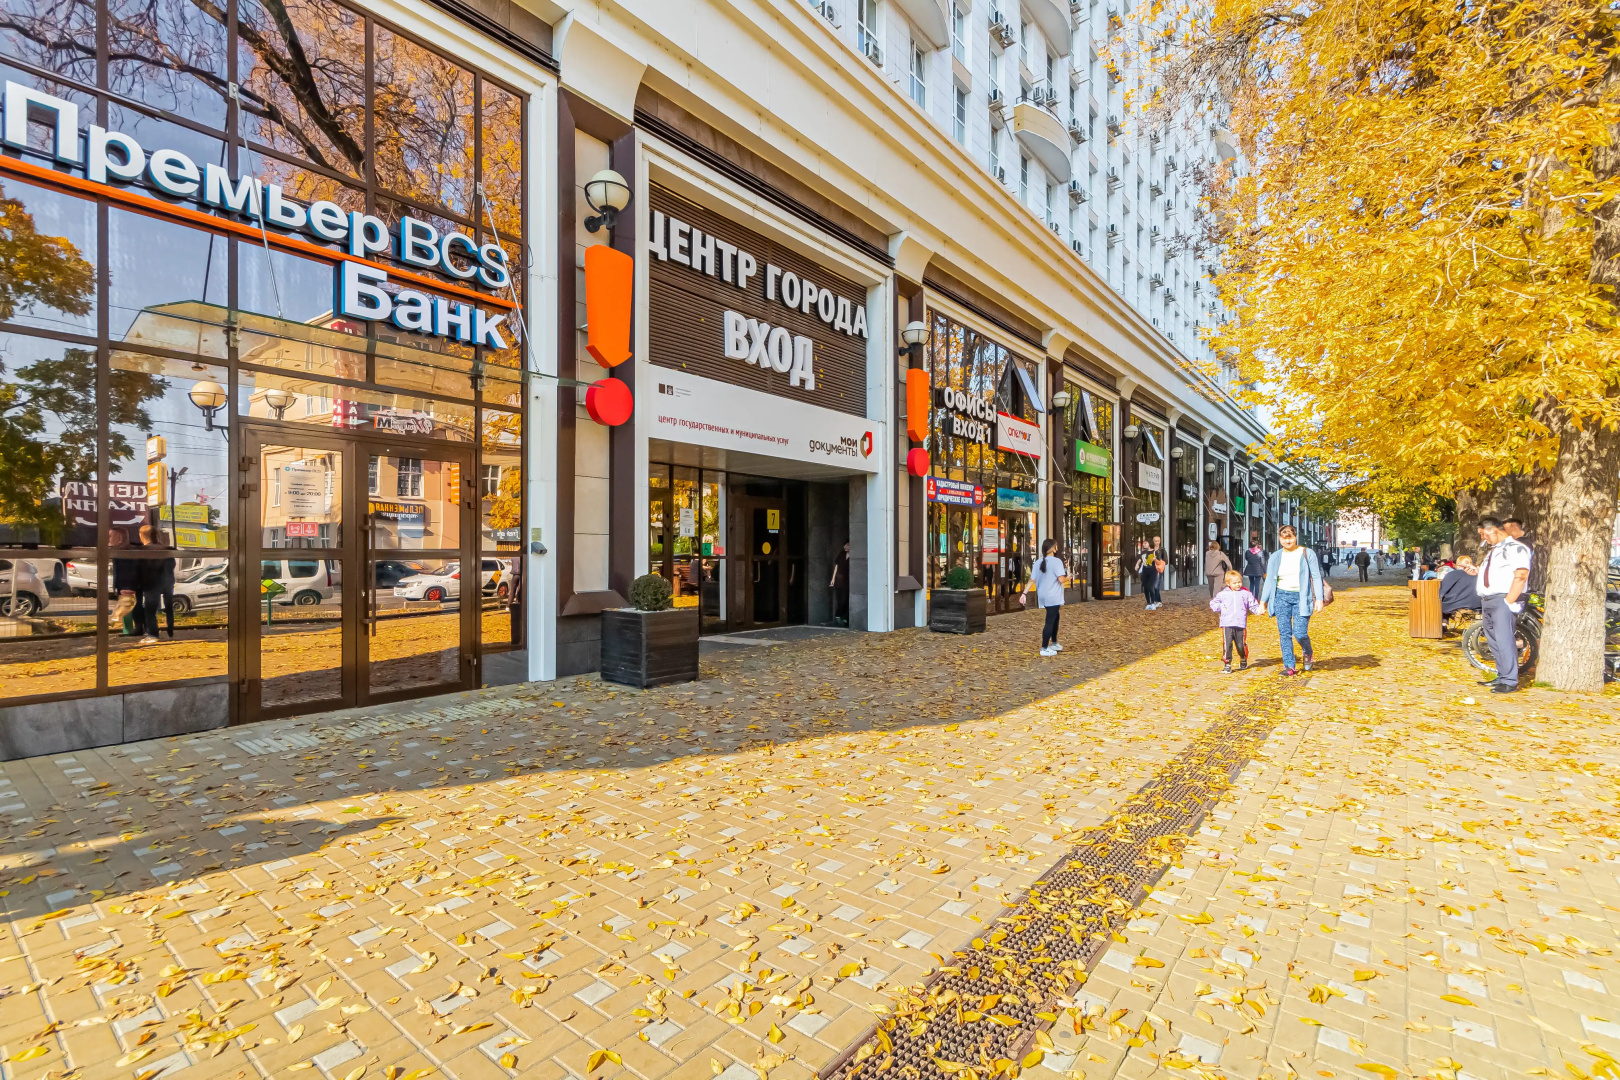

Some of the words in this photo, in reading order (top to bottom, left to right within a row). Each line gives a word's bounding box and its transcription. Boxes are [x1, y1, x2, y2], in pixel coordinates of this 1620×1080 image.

[3, 80, 391, 258] Премьер
[400, 215, 511, 289] BCS
[649, 210, 757, 289] ЦЕНТР
[764, 263, 869, 339] ГОРОДА
[341, 260, 509, 350] Банк
[723, 310, 815, 390] ВХОД
[944, 386, 997, 423] ОФИСЫ
[658, 415, 678, 426] центр
[679, 418, 729, 434] государственных
[736, 430, 776, 443] муниципальных
[777, 436, 789, 446] услуг
[953, 414, 986, 445] ВХОД
[986, 427, 991, 443] 1
[809, 439, 858, 457] документы
[929, 480, 934, 490] 2
[771, 512, 776, 526] 7
